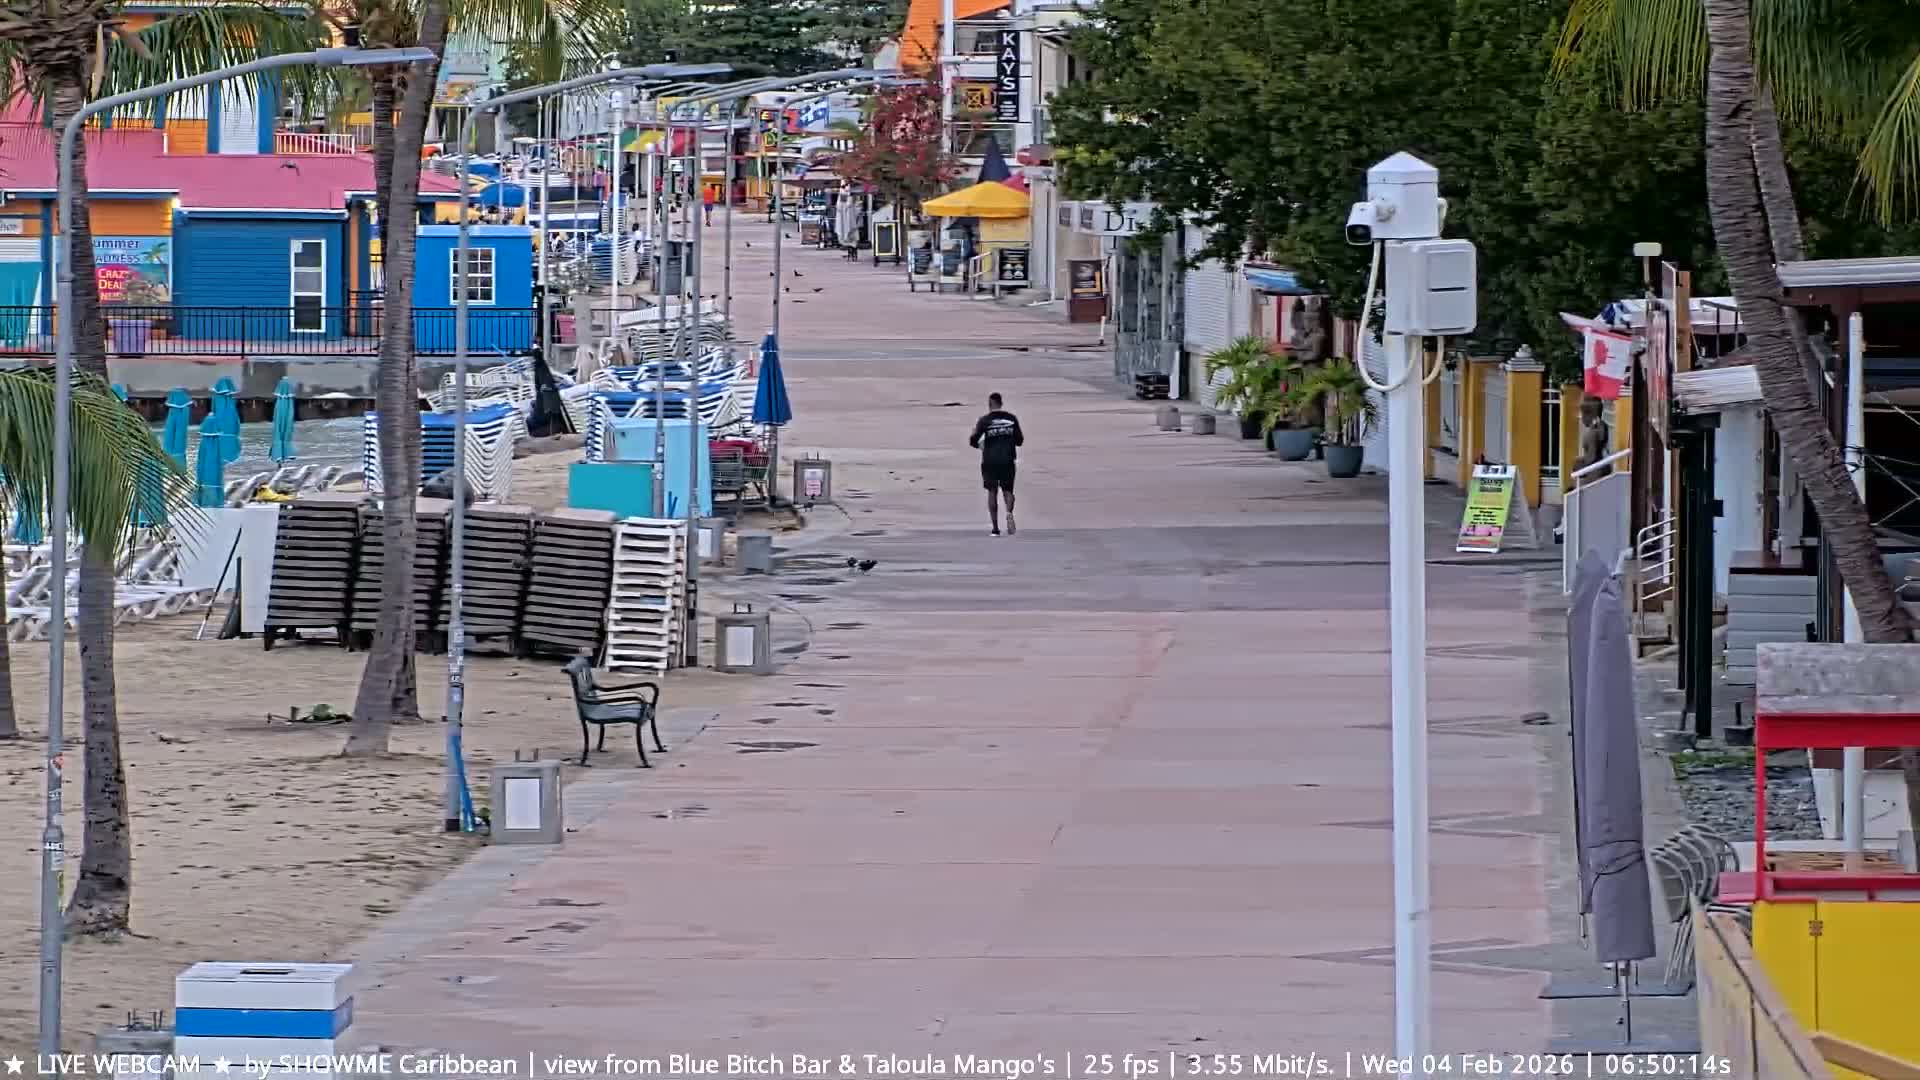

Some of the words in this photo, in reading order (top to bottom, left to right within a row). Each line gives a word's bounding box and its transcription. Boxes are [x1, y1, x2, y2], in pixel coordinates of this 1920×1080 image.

[1001, 32, 1017, 91] KAY'S
[93, 239, 140, 250] ummer
[96, 253, 141, 264] ADNESS
